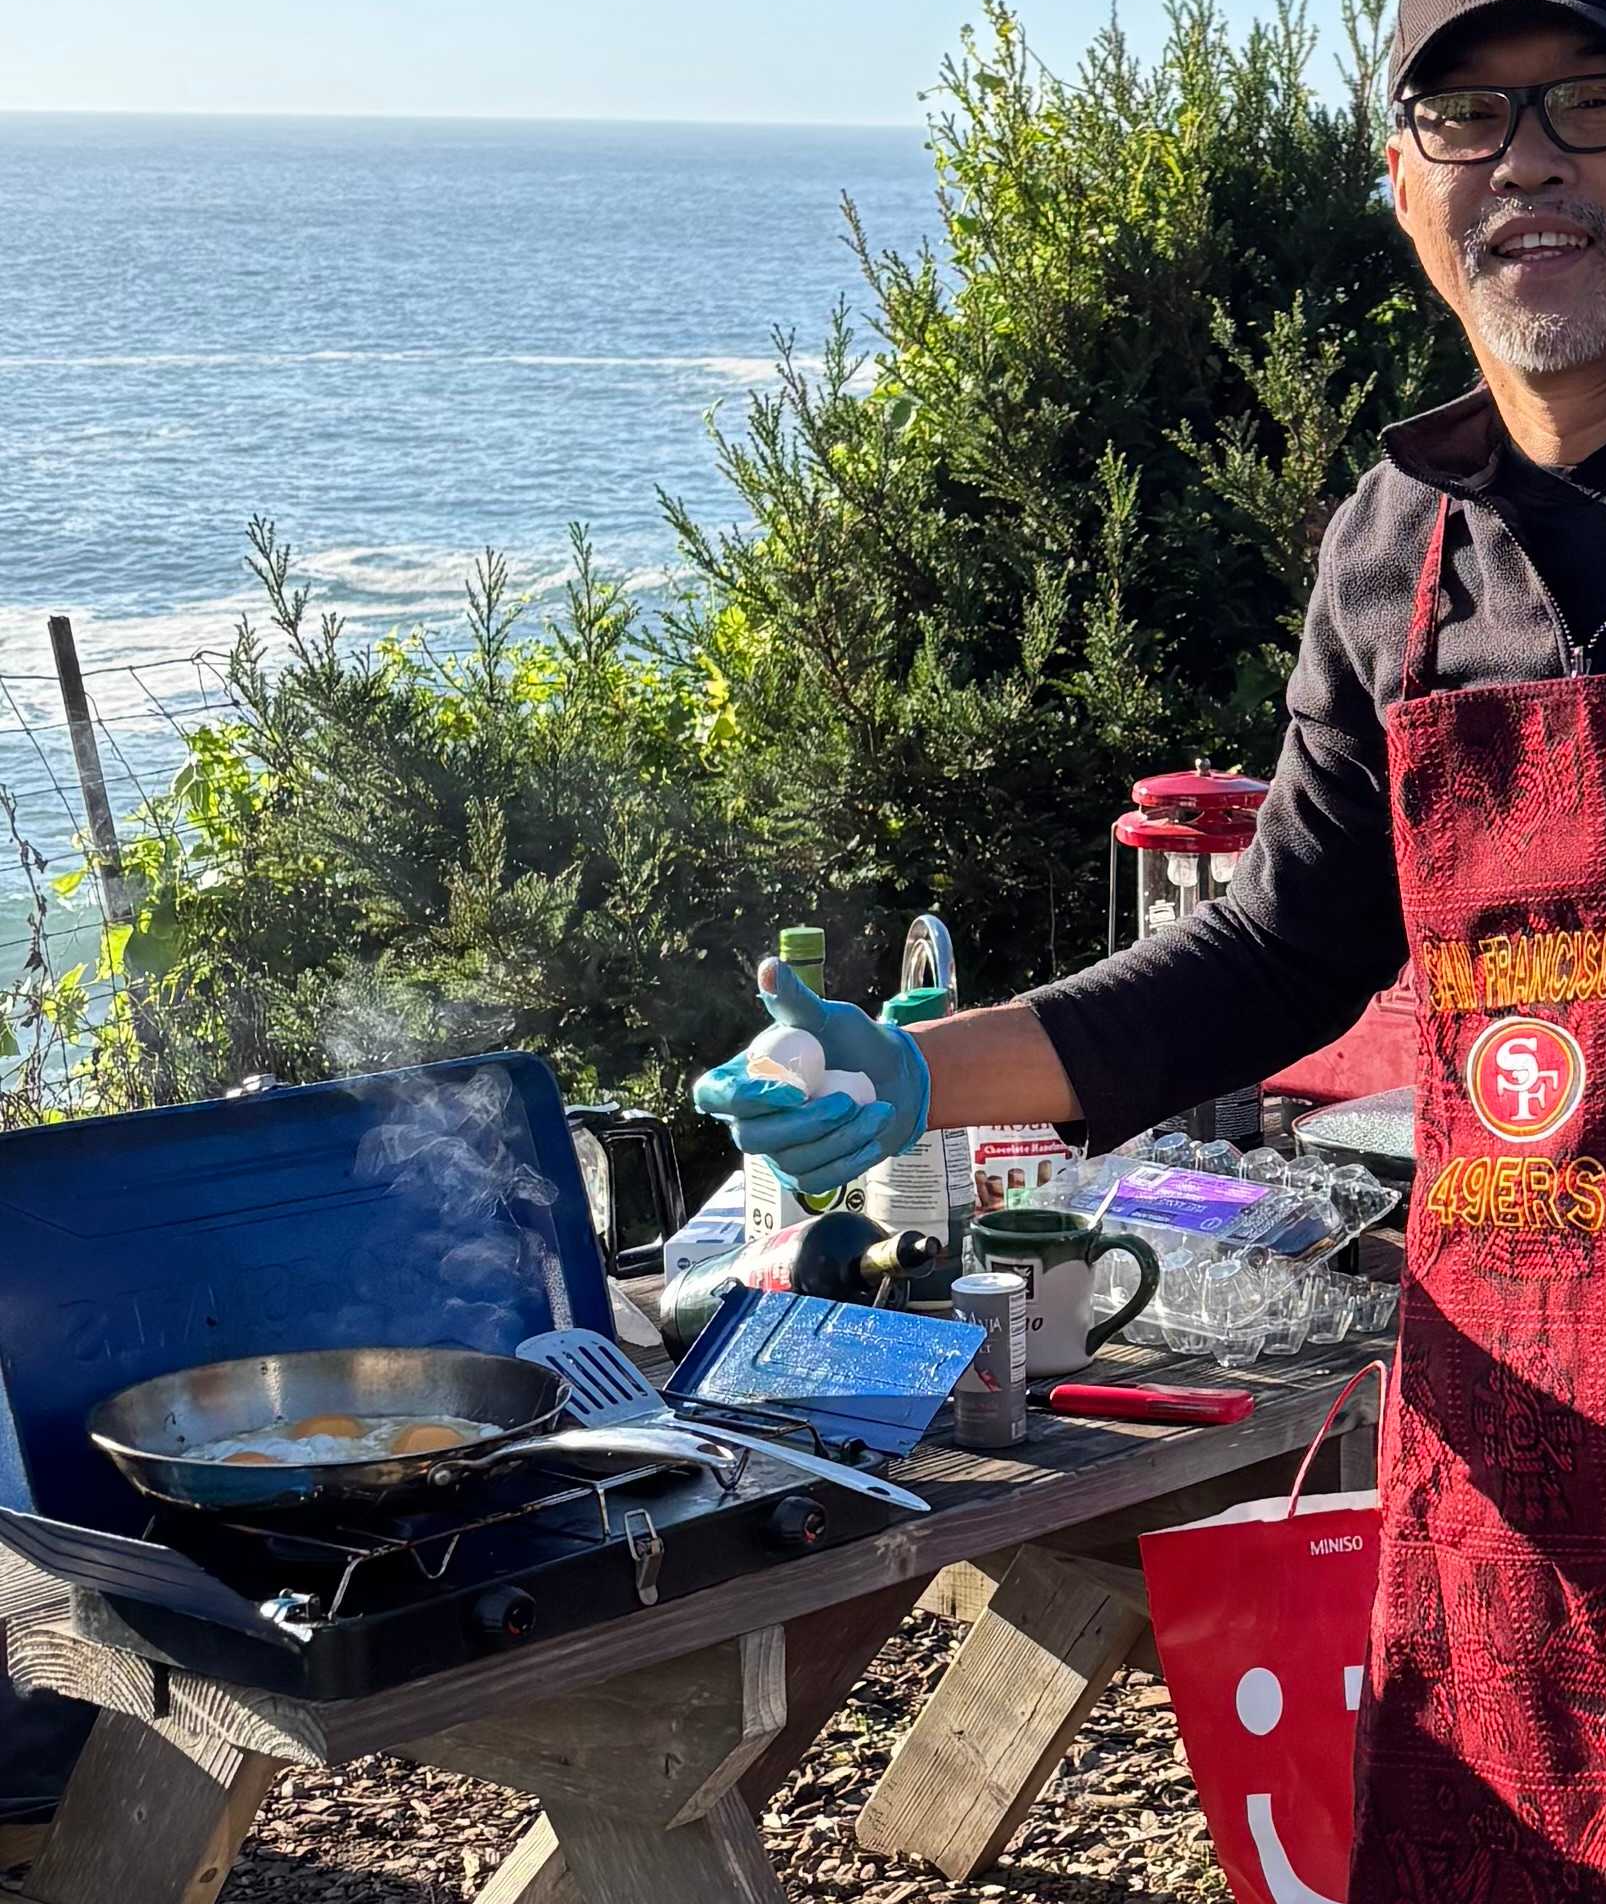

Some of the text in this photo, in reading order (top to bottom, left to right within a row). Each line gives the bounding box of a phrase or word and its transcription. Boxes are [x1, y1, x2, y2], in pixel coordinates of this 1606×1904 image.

[1423, 941, 1478, 1012] SAN
[1495, 1037, 1559, 1121] SF
[1427, 1156, 1606, 1232] 49ERS
[1310, 1535, 1363, 1556] MINISO
